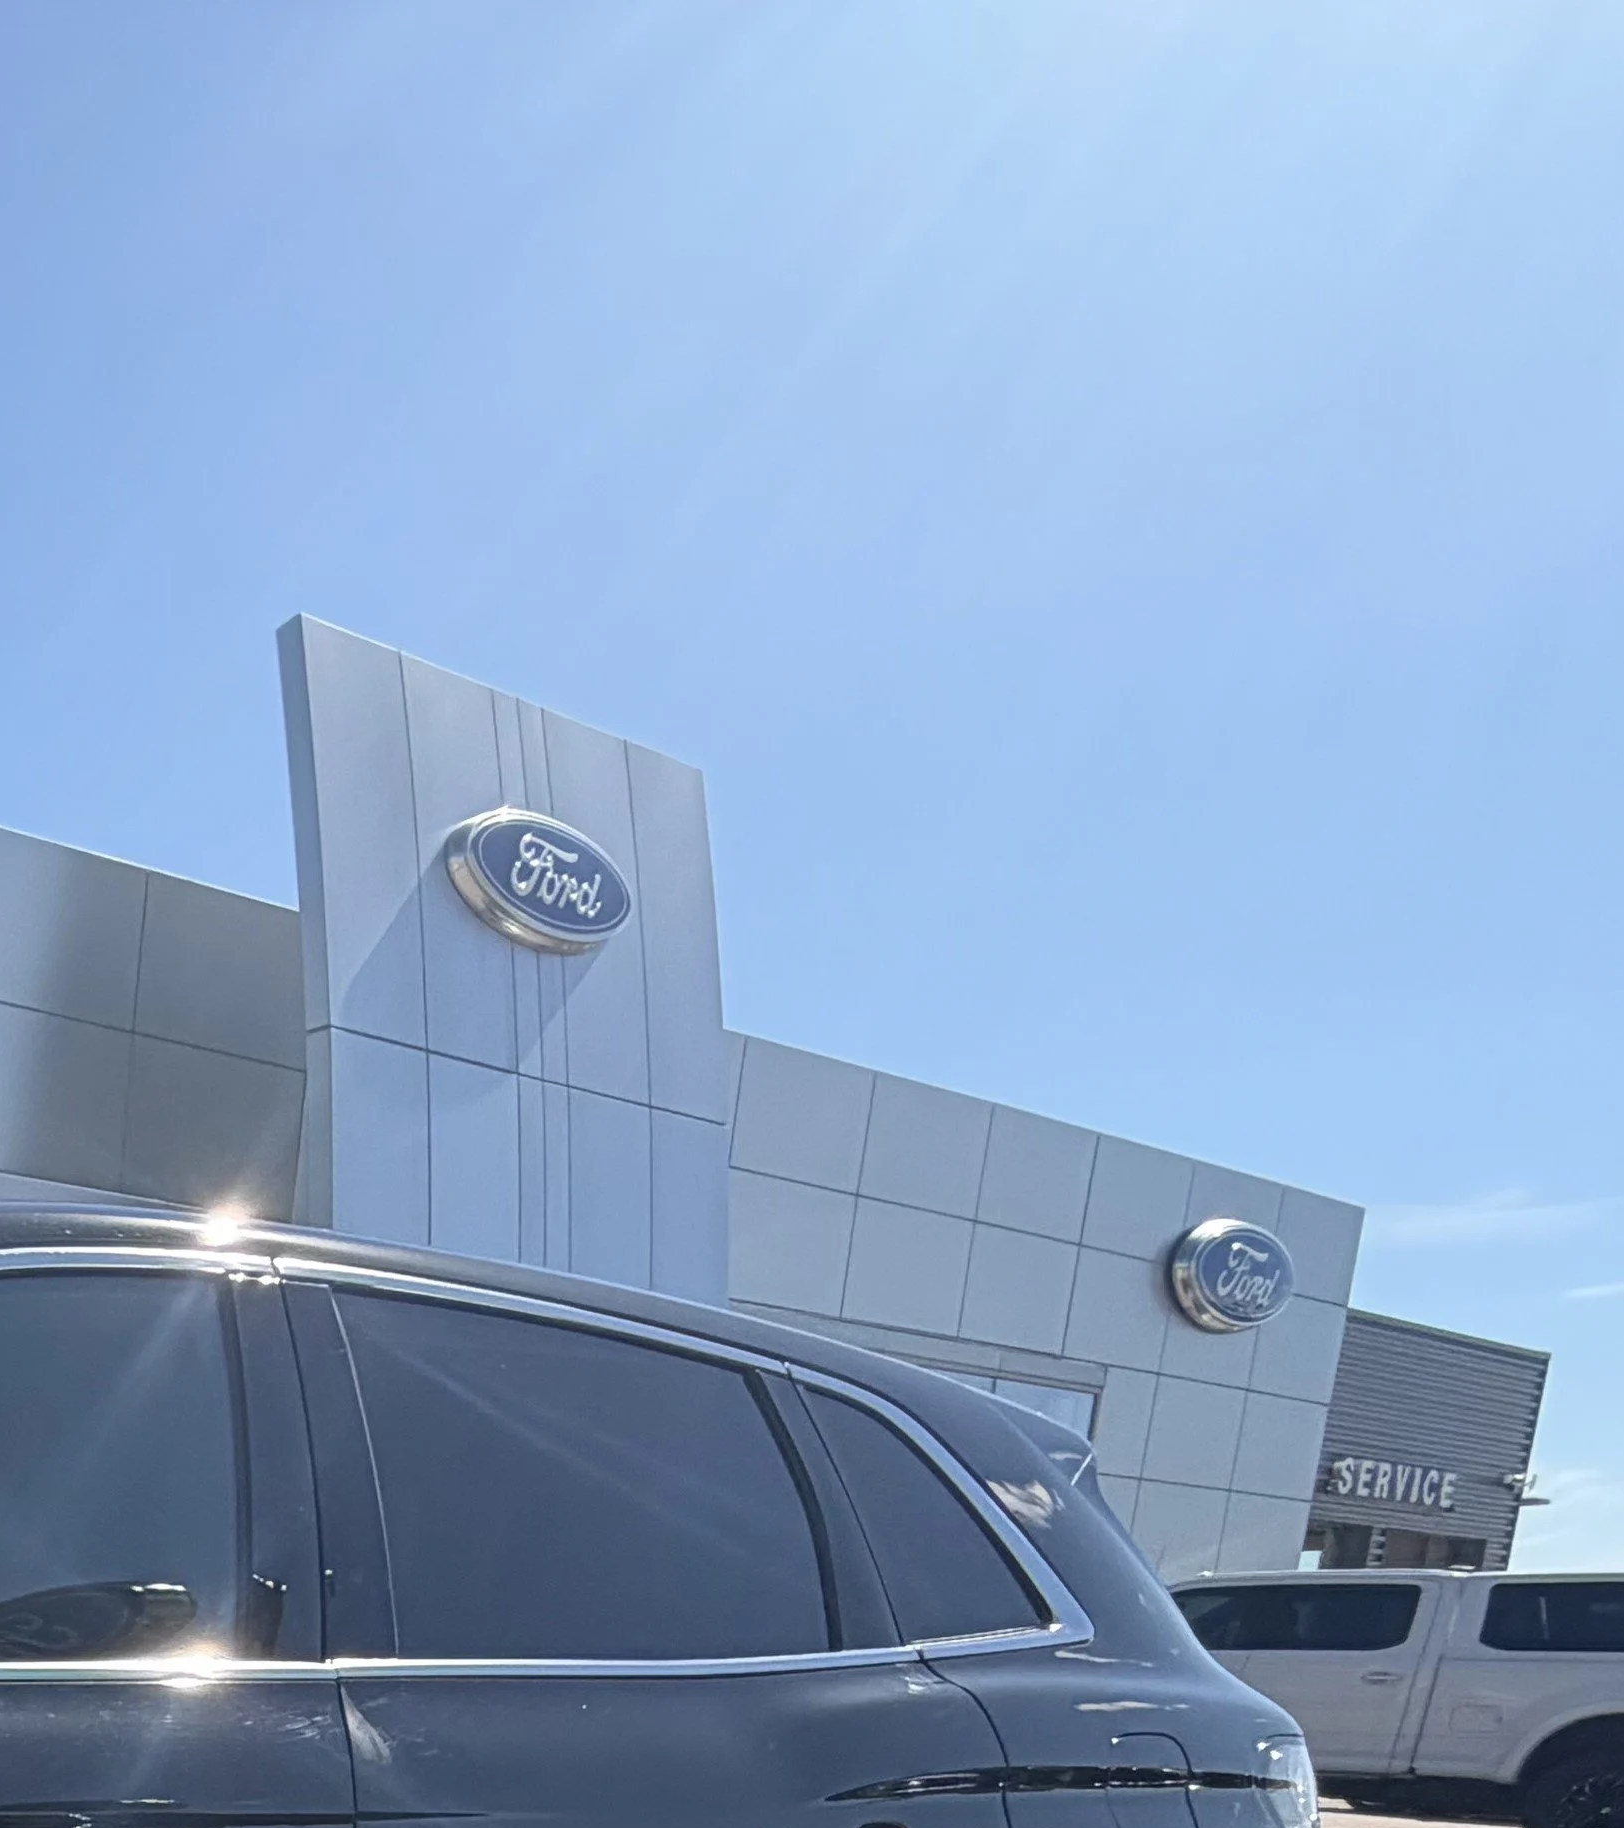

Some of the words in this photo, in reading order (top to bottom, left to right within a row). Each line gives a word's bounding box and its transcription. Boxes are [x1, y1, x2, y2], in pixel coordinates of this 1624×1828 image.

[511, 832, 601, 918] Ford
[1217, 1242, 1280, 1307] Ford
[1334, 1457, 1458, 1508] SERVICE
